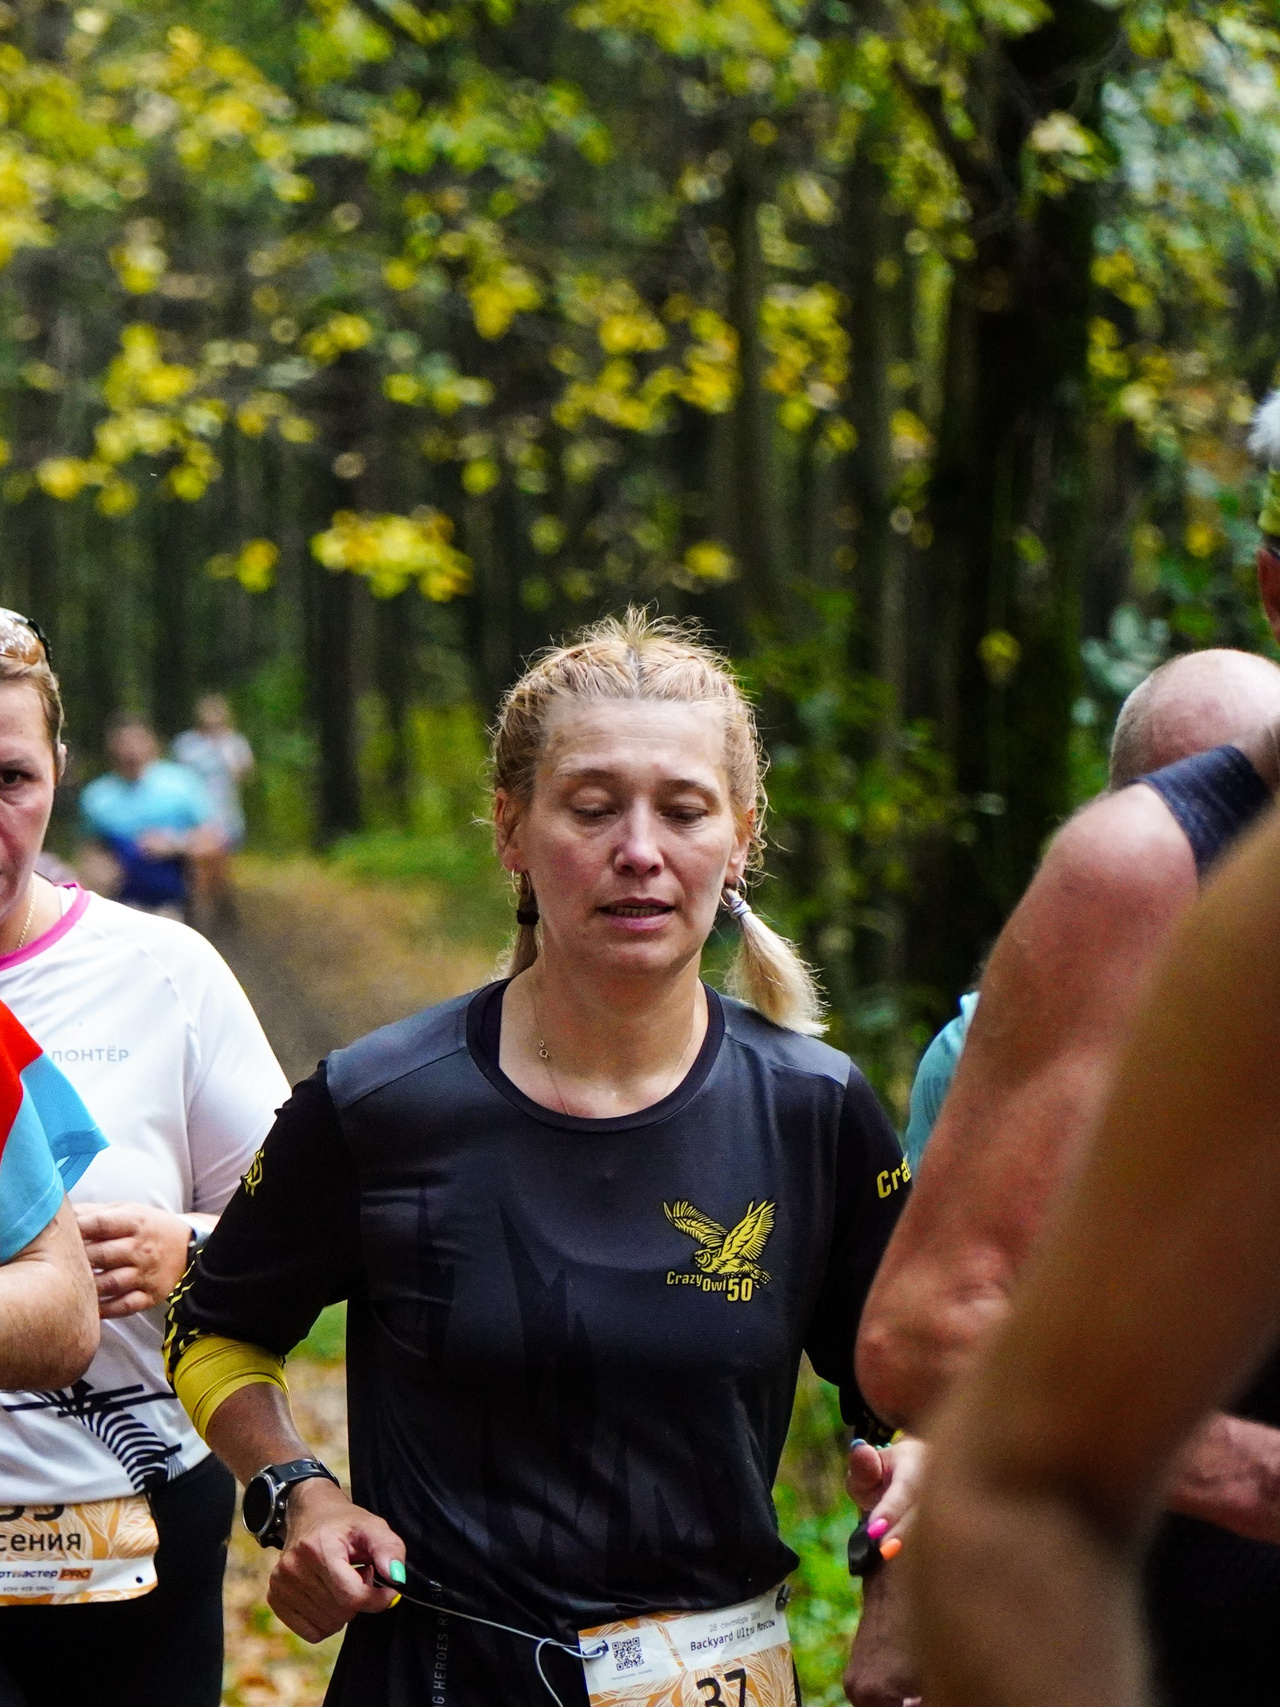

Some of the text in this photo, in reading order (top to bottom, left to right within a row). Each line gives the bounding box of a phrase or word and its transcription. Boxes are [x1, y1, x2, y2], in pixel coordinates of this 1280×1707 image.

[52, 1045, 130, 1062] ЛОНТЁР
[876, 1155, 912, 1199] Cra
[727, 1278, 753, 1302] 50
[690, 1631, 734, 1651] Backyard
